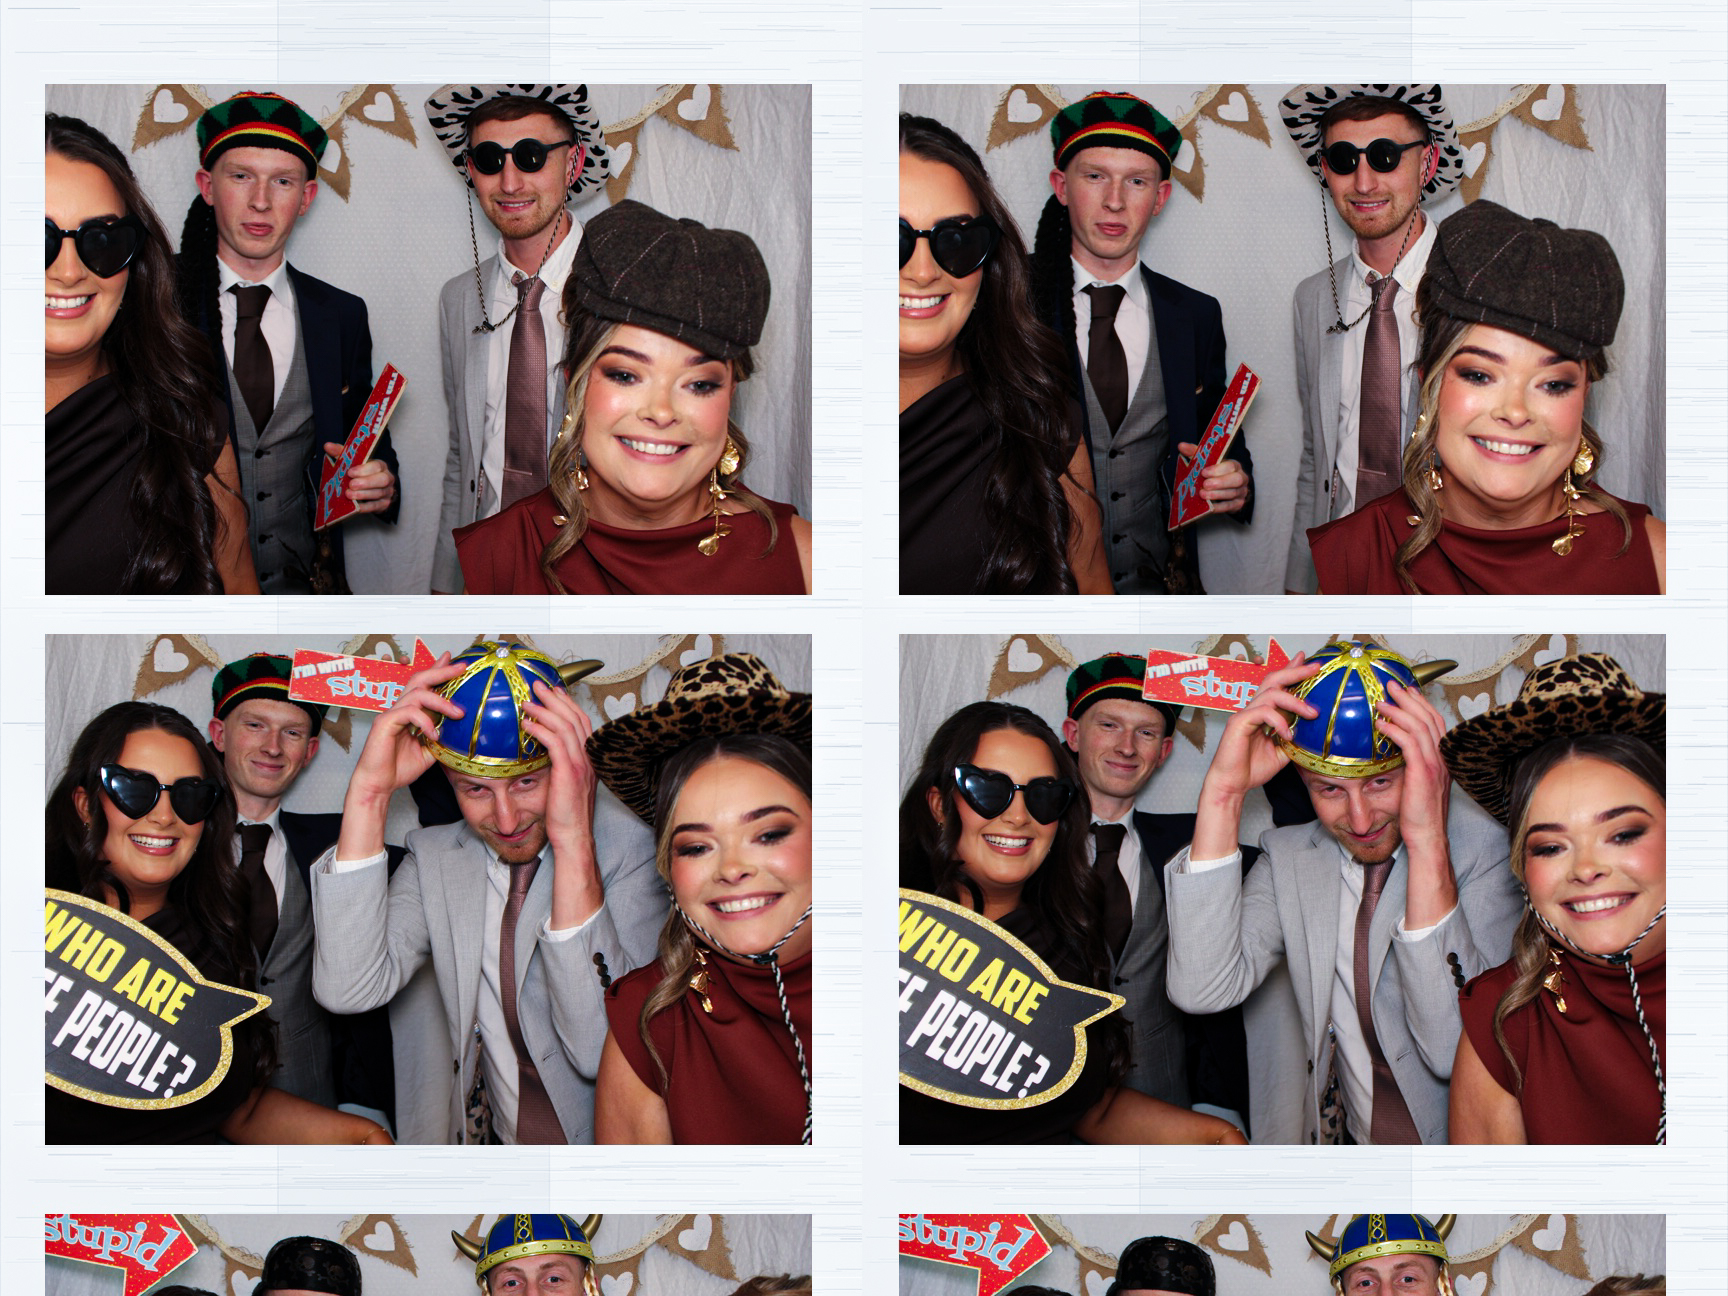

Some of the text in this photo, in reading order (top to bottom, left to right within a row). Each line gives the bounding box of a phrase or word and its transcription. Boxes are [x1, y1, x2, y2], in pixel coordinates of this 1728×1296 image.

[323, 401, 380, 523] stupid
[1177, 401, 1234, 523] stupid
[317, 657, 355, 675] WITH
[326, 670, 404, 708] stup
[1171, 657, 1209, 675] WITH
[1180, 670, 1258, 708] stup
[112, 957, 196, 1026] ARE
[966, 957, 1050, 1026] ARE
[51, 989, 197, 1099] PEOPLE?
[905, 989, 1051, 1099] PEOPLE?
